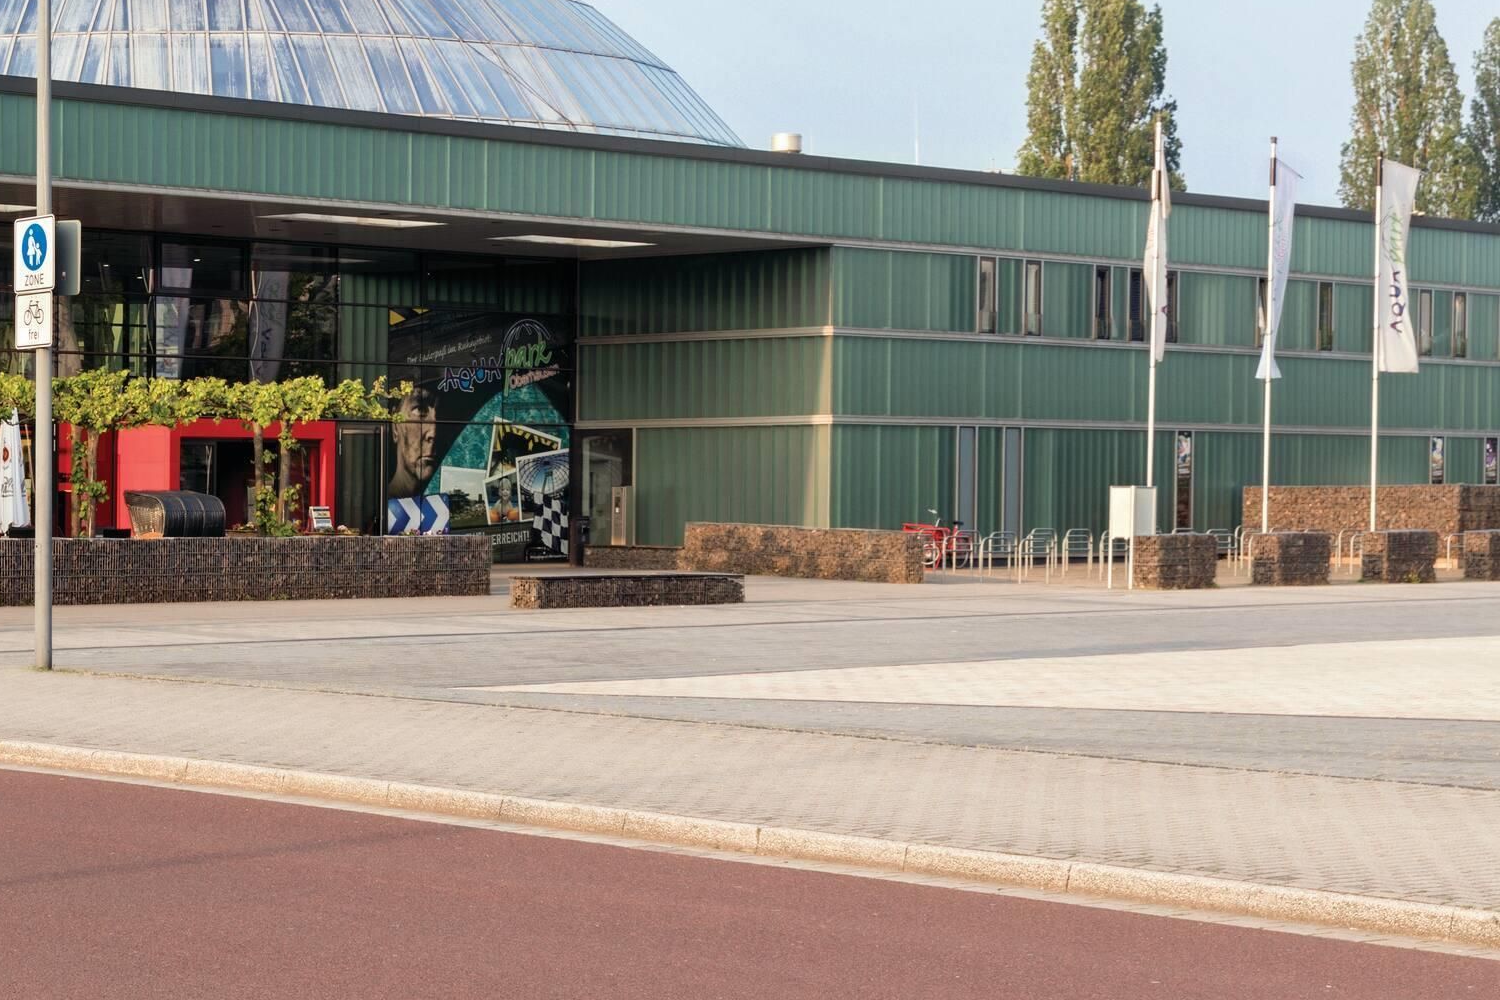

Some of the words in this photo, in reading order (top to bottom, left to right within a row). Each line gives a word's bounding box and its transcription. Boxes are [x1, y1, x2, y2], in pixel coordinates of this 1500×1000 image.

[24, 273, 45, 287] ZONE
[28, 329, 40, 340] frei
[491, 530, 530, 545] ERREICHT!
